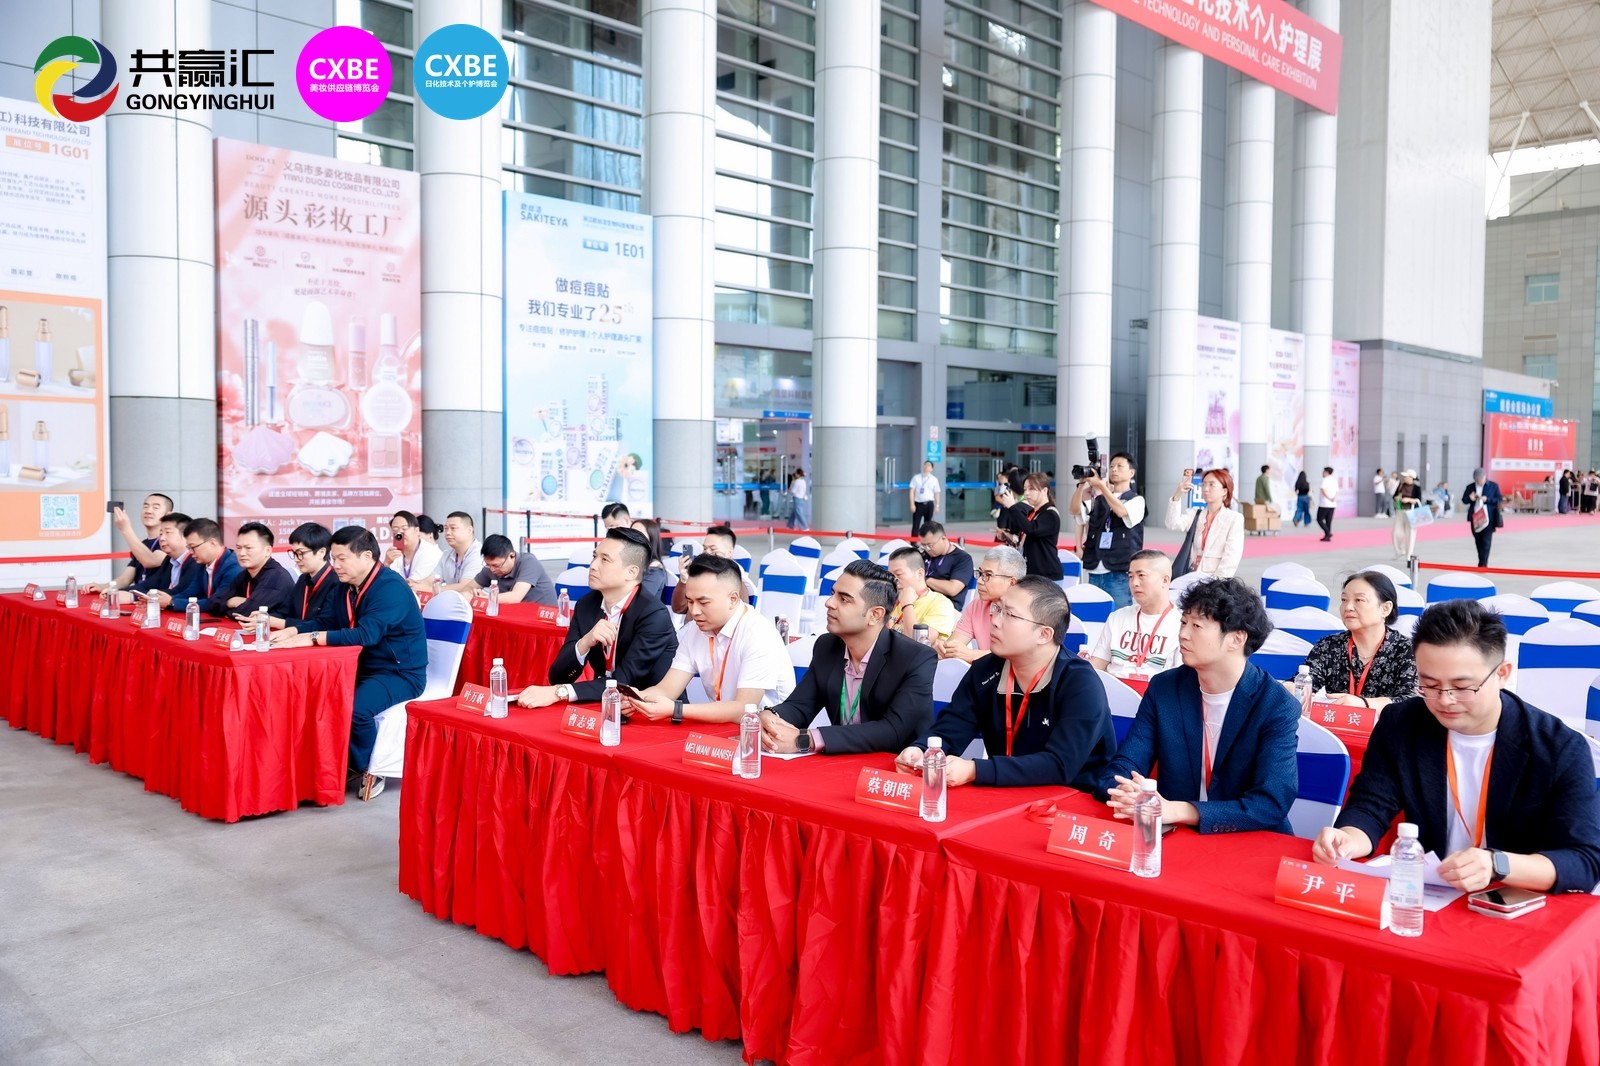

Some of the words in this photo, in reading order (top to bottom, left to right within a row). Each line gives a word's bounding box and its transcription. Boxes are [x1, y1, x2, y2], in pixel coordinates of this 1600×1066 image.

[1143, 0, 1201, 31] TECHNOLOGY
[1202, 23, 1220, 42] AND
[1221, 33, 1260, 63] PERSONAL
[1262, 52, 1281, 72] CARE
[1281, 61, 1318, 91] EXHIBITION
[1181, 0, 1323, 72] 化技术个人护理展
[52, 143, 89, 160] 1G01
[283, 161, 400, 190] 义乌市多姿化妆品有限公司
[283, 174, 304, 183] YIWU
[305, 177, 331, 188] DUOZI
[332, 181, 371, 194] COSMETIC
[243, 192, 402, 238] 源头彩妆工厂
[520, 211, 568, 228] SAKITEYA
[615, 242, 645, 259] 1E01
[555, 277, 610, 299] 做痘痘贴
[1119, 630, 1168, 655] GUCCI
[567, 713, 597, 731] 曹志强
[1322, 709, 1362, 727] 嘉宾
[684, 742, 710, 756] MELWANI
[711, 747, 735, 761] MANISH
[867, 776, 913, 801] 蔡朝晖
[1301, 873, 1356, 905] 尹平
